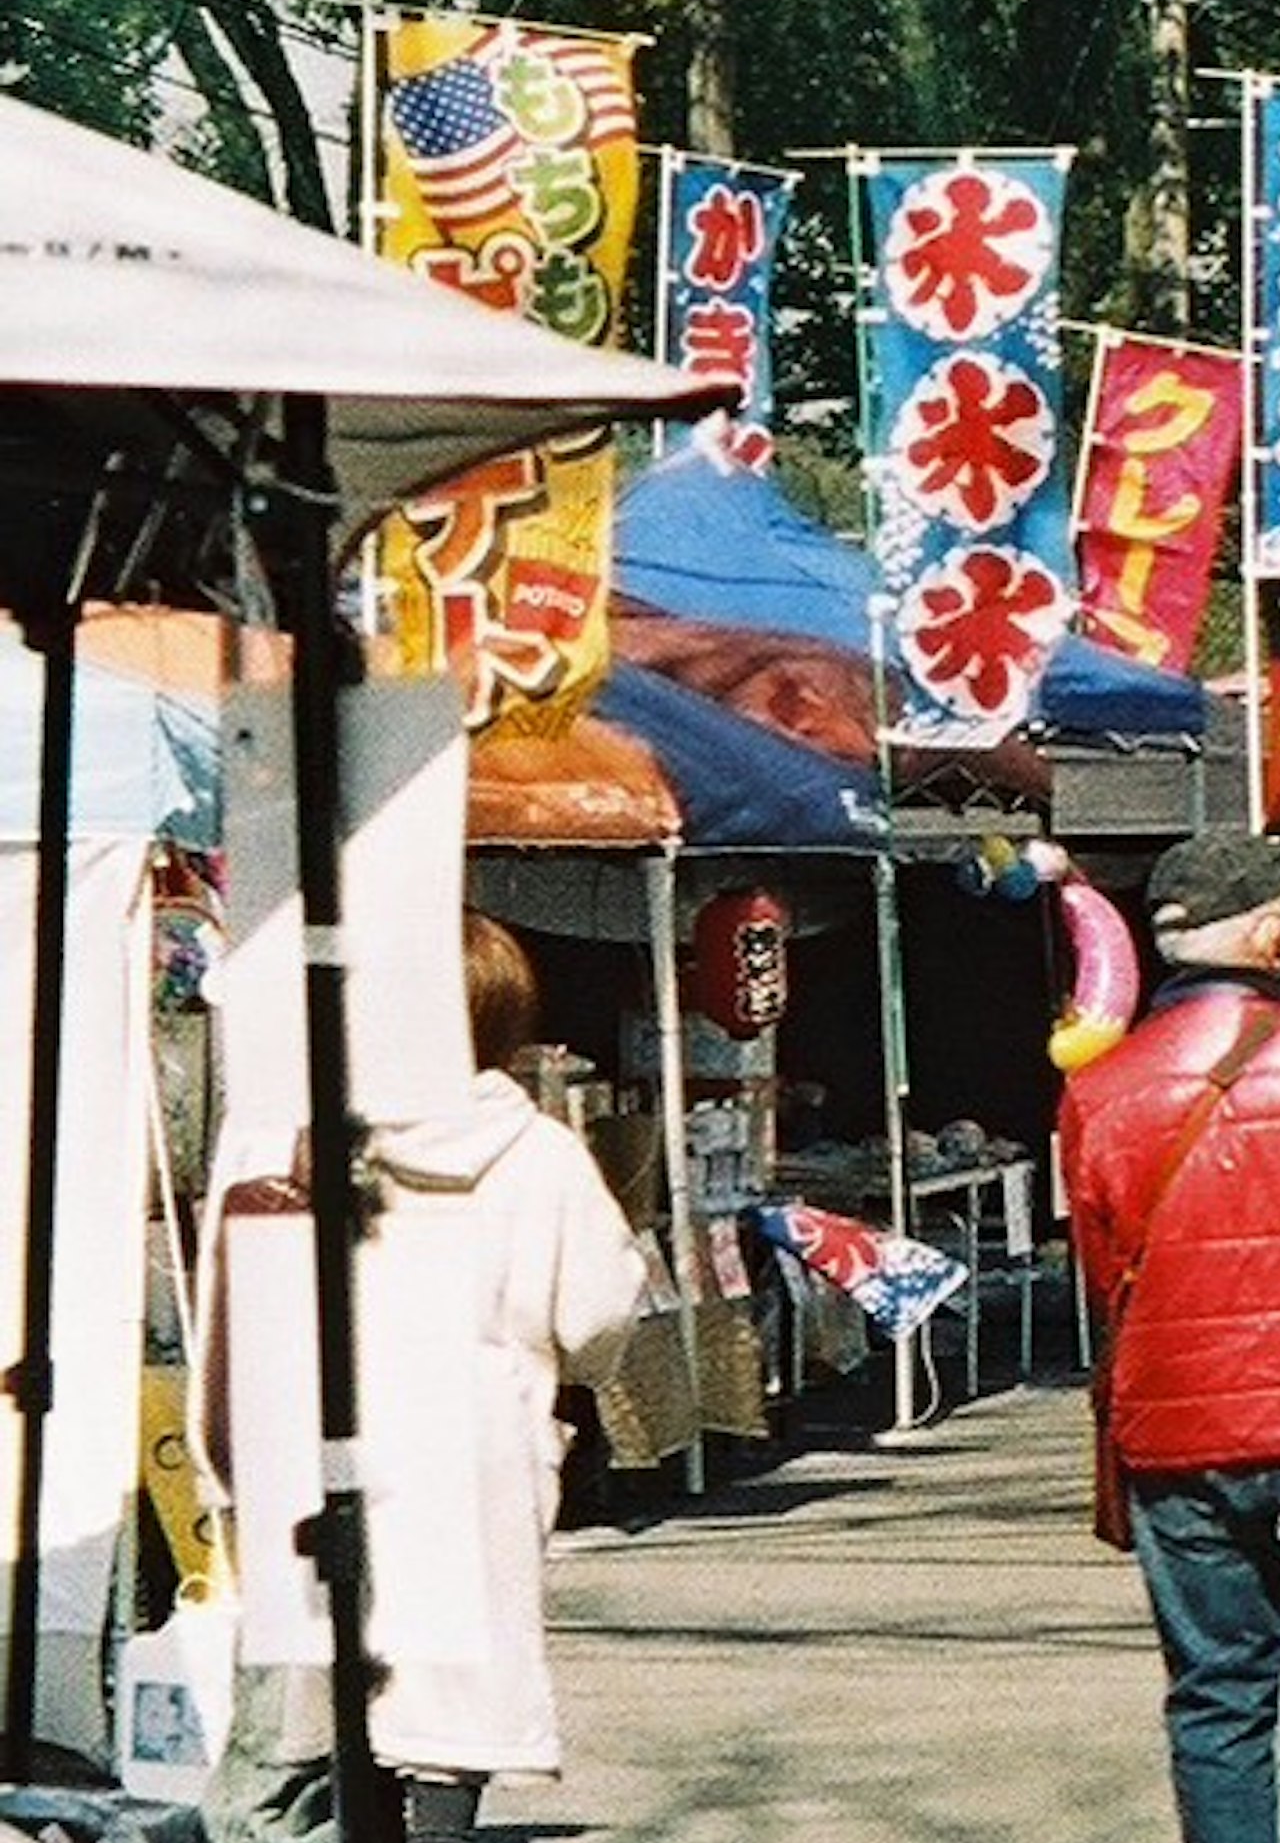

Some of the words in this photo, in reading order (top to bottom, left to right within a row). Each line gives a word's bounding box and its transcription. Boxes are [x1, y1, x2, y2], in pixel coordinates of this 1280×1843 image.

[492, 50, 608, 457] もちも
[680, 185, 772, 475] かき
[903, 174, 1056, 711] 氷氷氷
